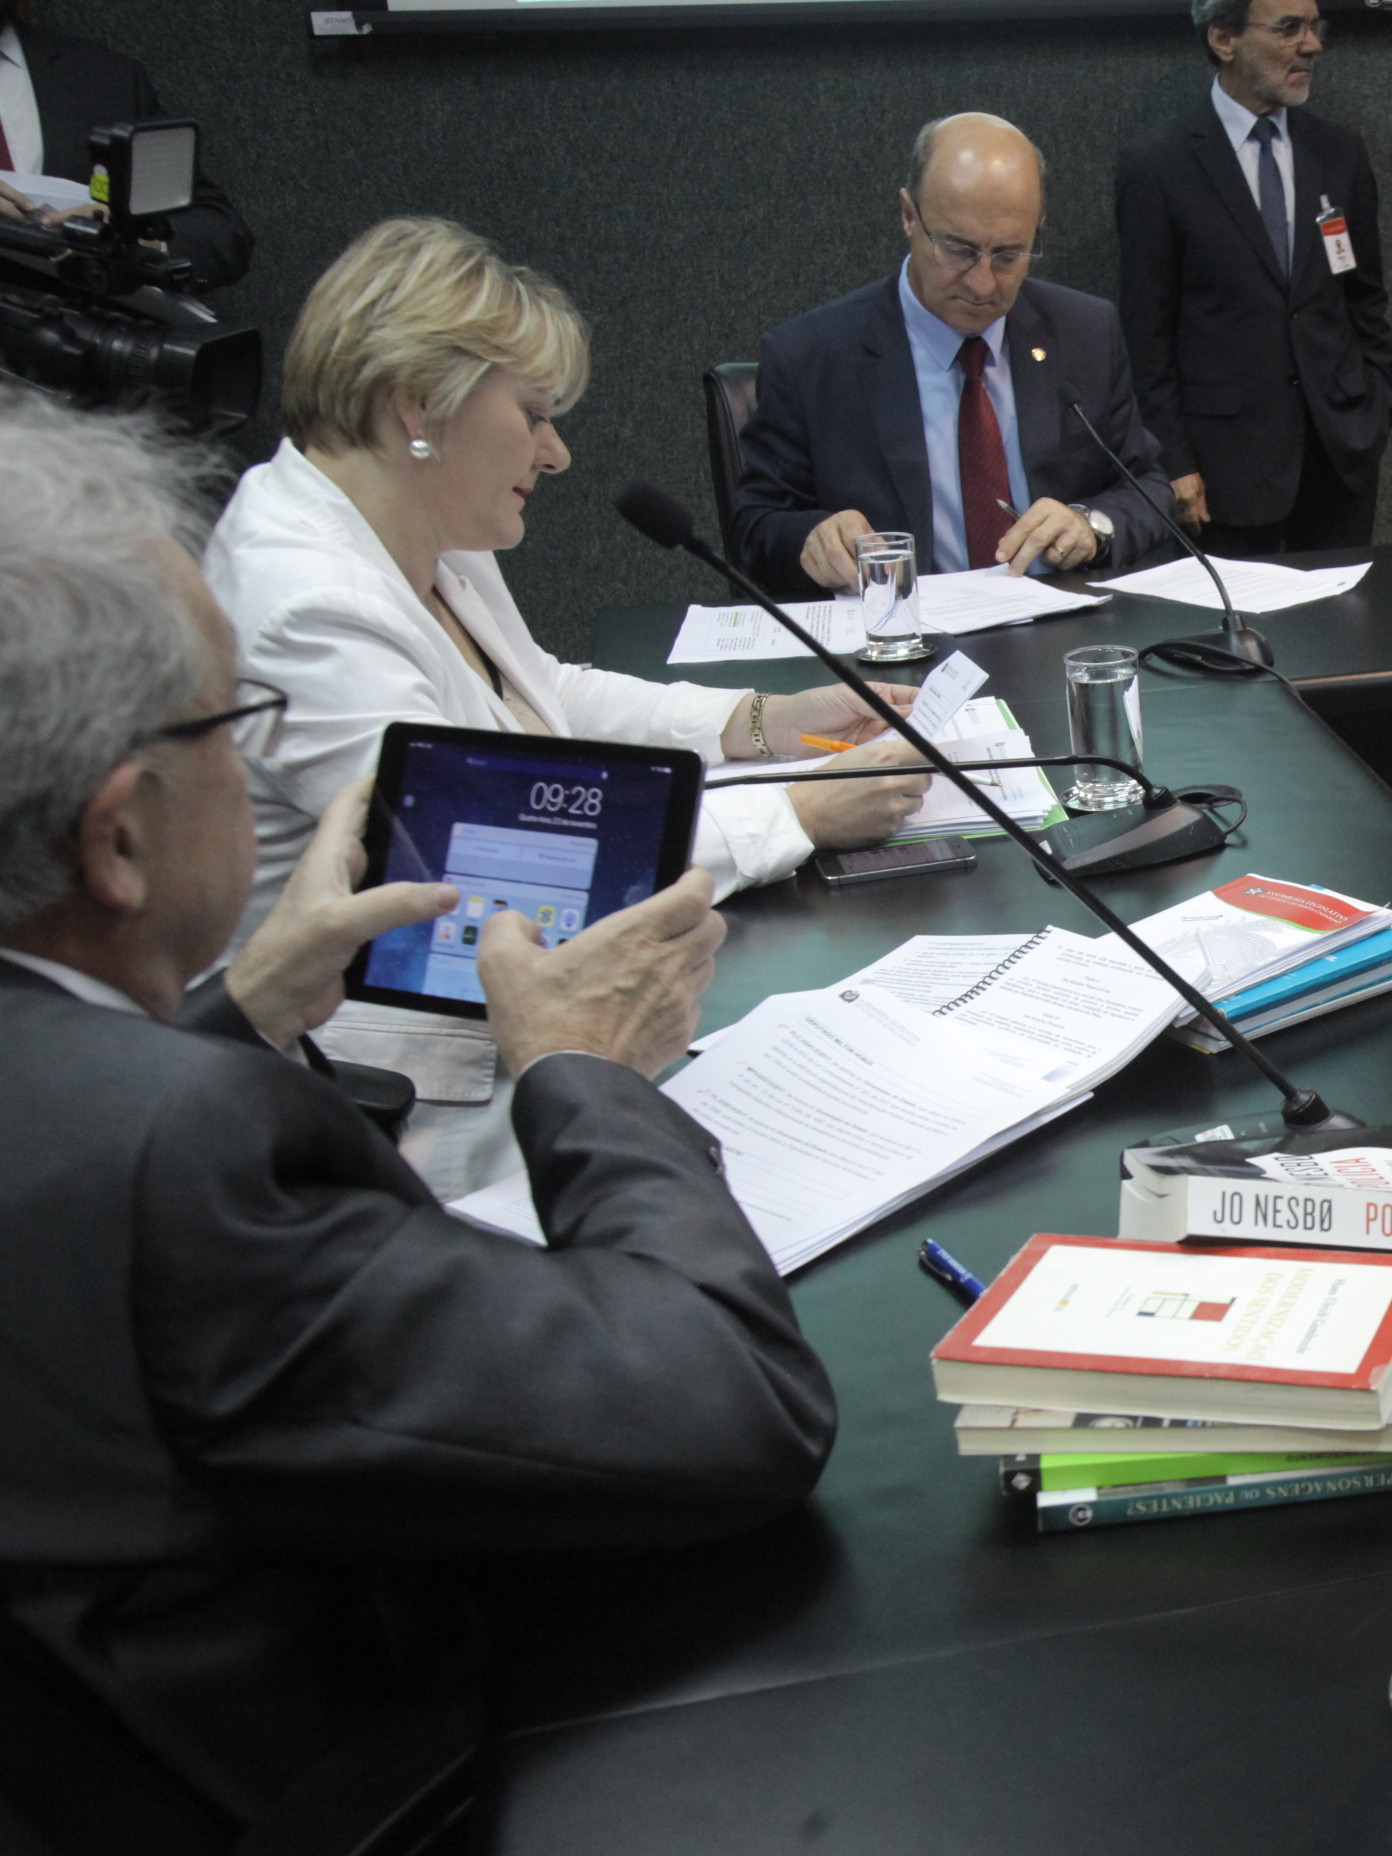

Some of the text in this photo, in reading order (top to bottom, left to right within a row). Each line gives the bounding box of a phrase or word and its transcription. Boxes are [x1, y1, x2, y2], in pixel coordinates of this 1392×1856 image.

[530, 782, 603, 816] 09:28
[1213, 1191, 1243, 1225] JO
[1254, 1193, 1333, 1233] NESBØ
[1222, 1271, 1283, 1352] DOS SENTIDOS
[1246, 1267, 1314, 1361] MODERNIZAÇÃO
[1126, 1493, 1235, 1517] PACIENTES?
